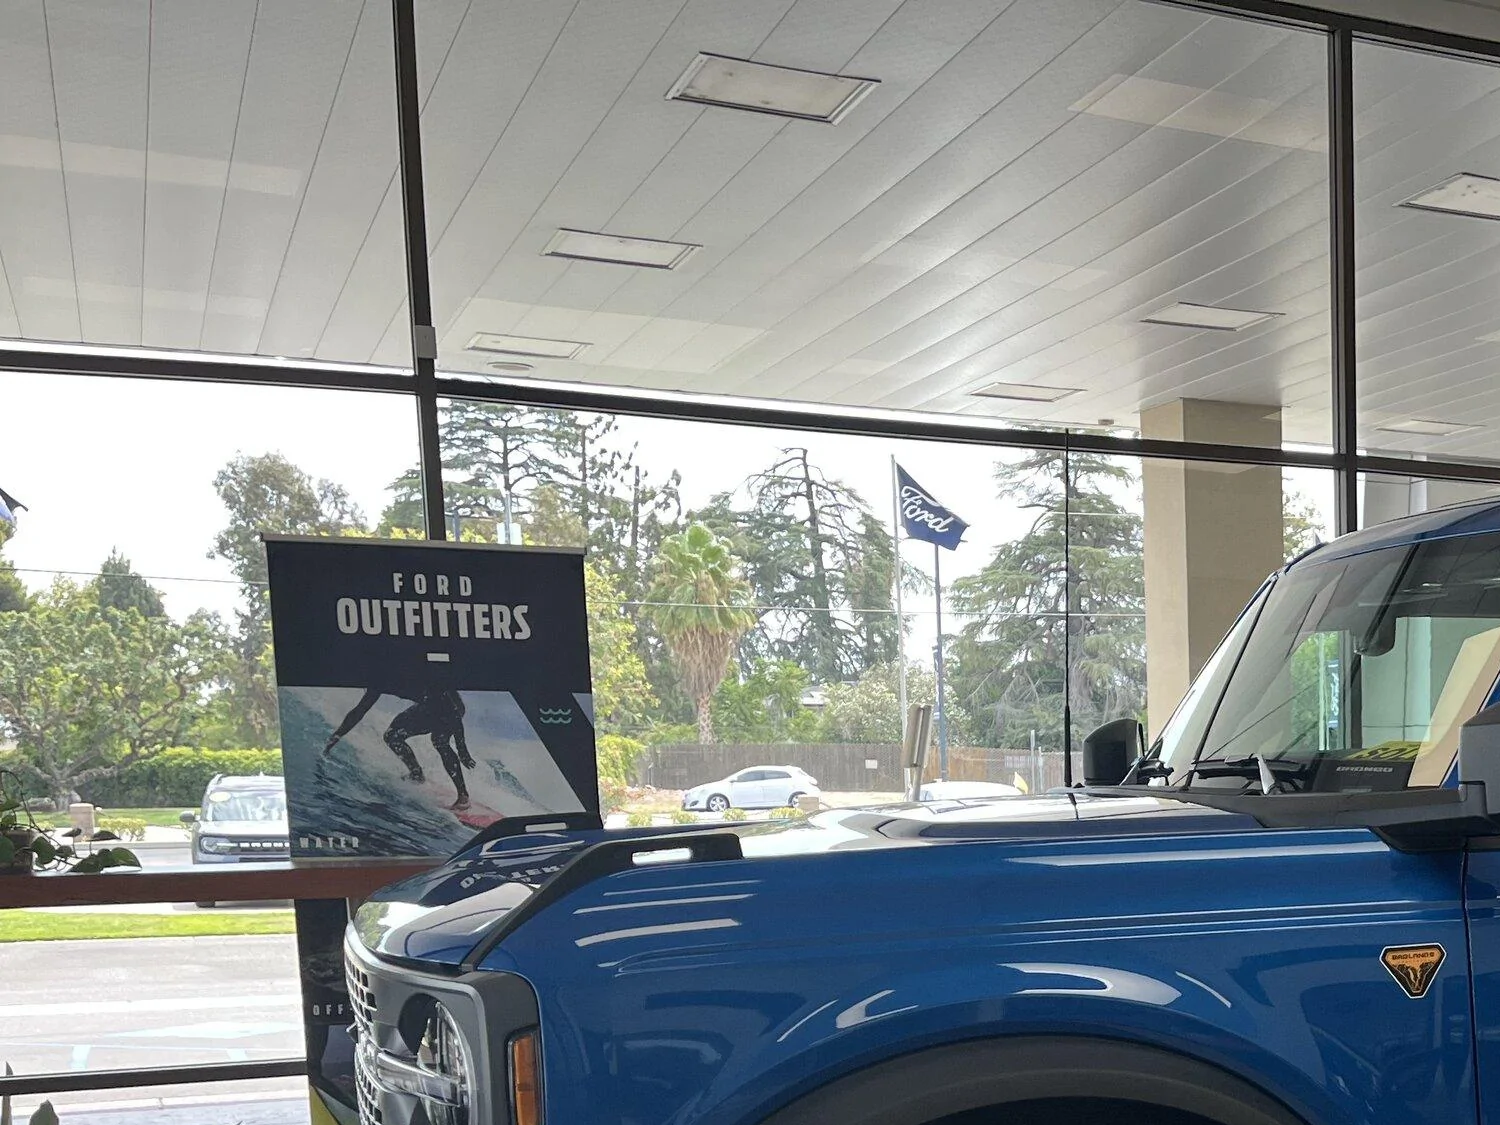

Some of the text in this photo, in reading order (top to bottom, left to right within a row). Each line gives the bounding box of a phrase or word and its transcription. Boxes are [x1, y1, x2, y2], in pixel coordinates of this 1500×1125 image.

[901, 486, 954, 532] Ford
[393, 572, 472, 597] FORD
[336, 597, 532, 641] OUTFITTERS
[300, 836, 359, 849] WATER
[1391, 951, 1435, 960] BADLANDS
